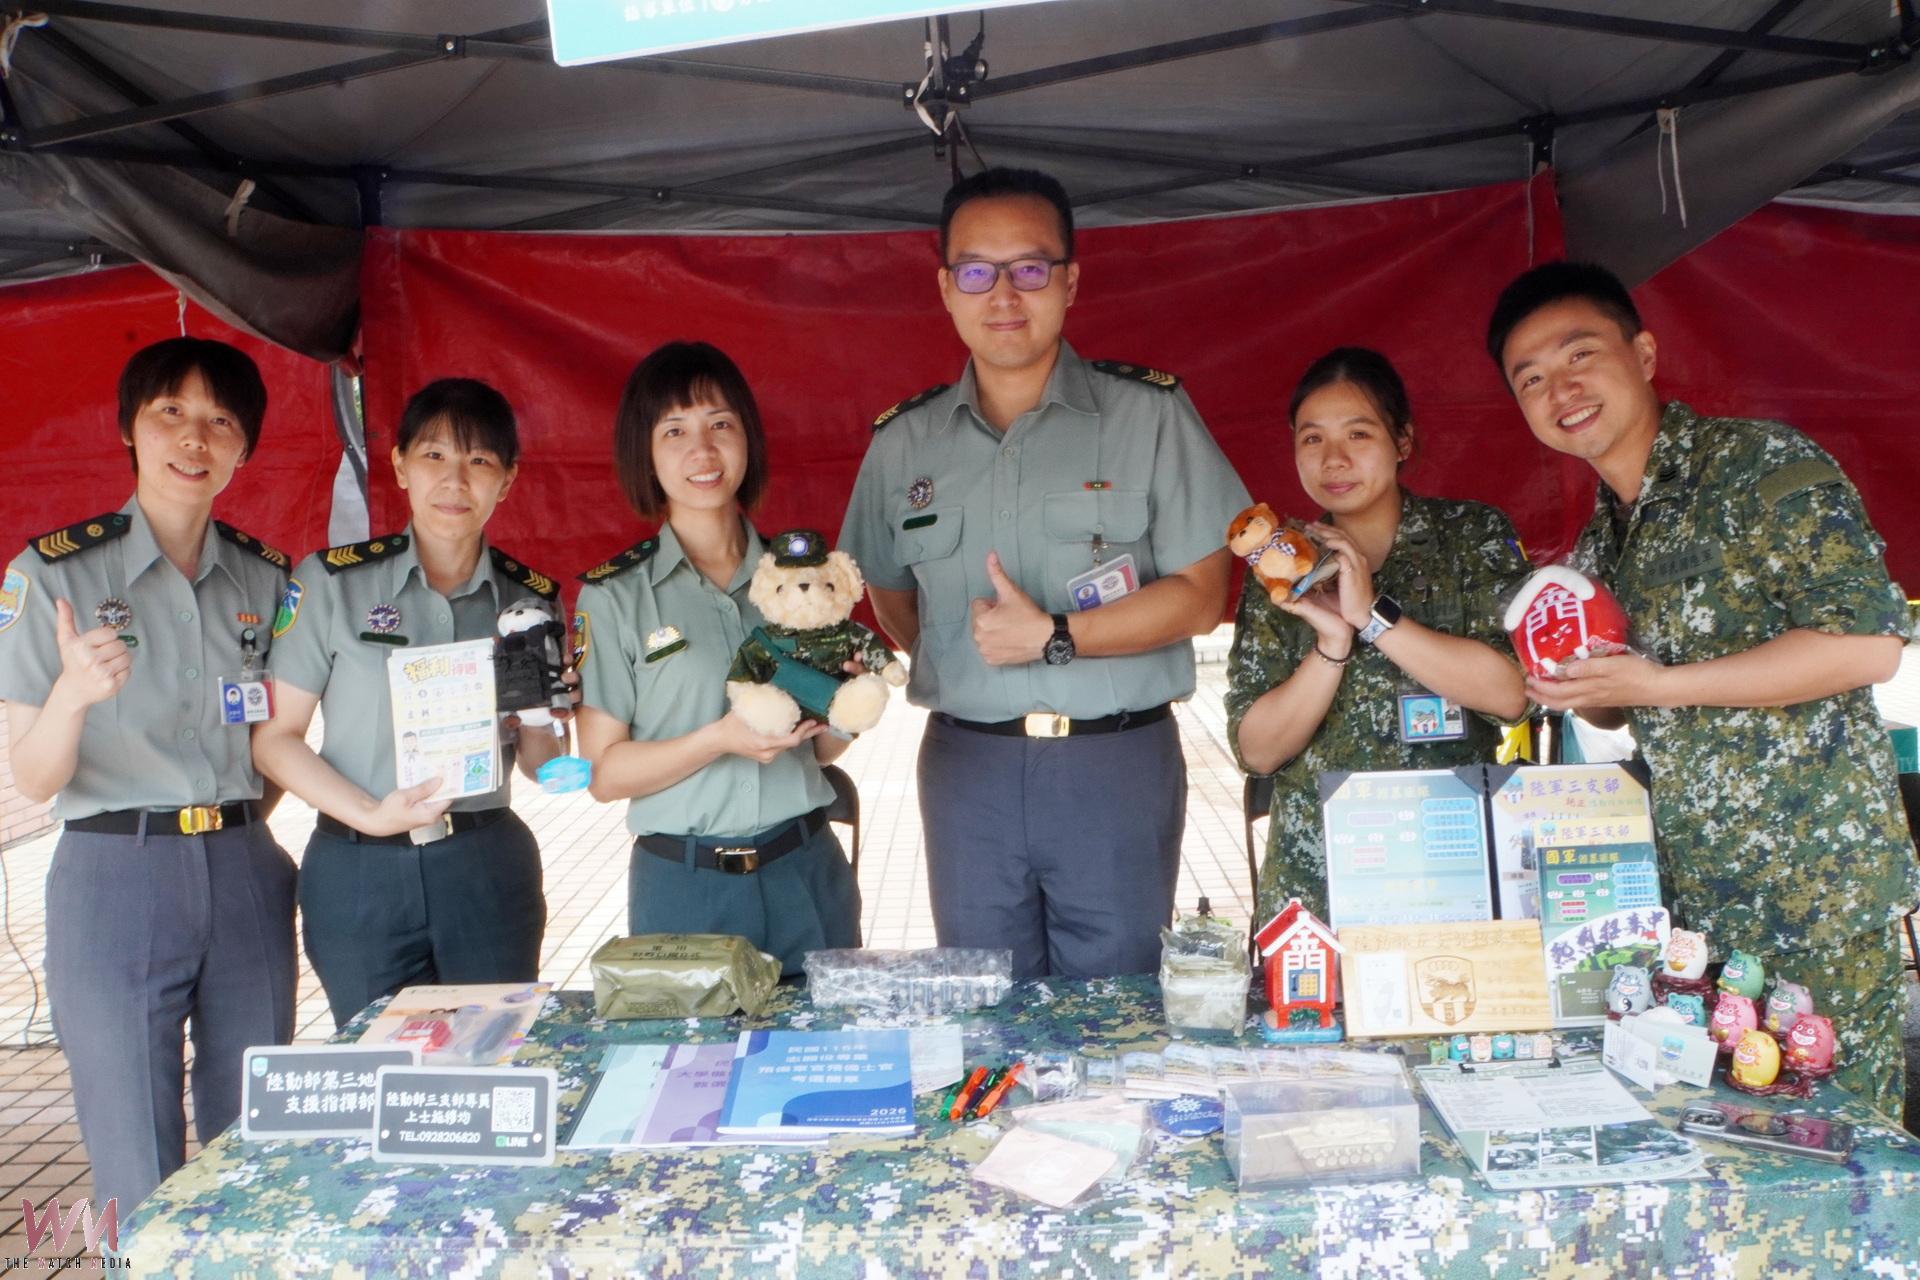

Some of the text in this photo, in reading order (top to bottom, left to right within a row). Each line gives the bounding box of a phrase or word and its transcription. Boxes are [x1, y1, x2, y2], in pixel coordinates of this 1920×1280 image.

[1529, 777, 1620, 798] 陸軍三支部
[869, 1106, 908, 1117] 2026
[506, 1136, 529, 1148] LINE
